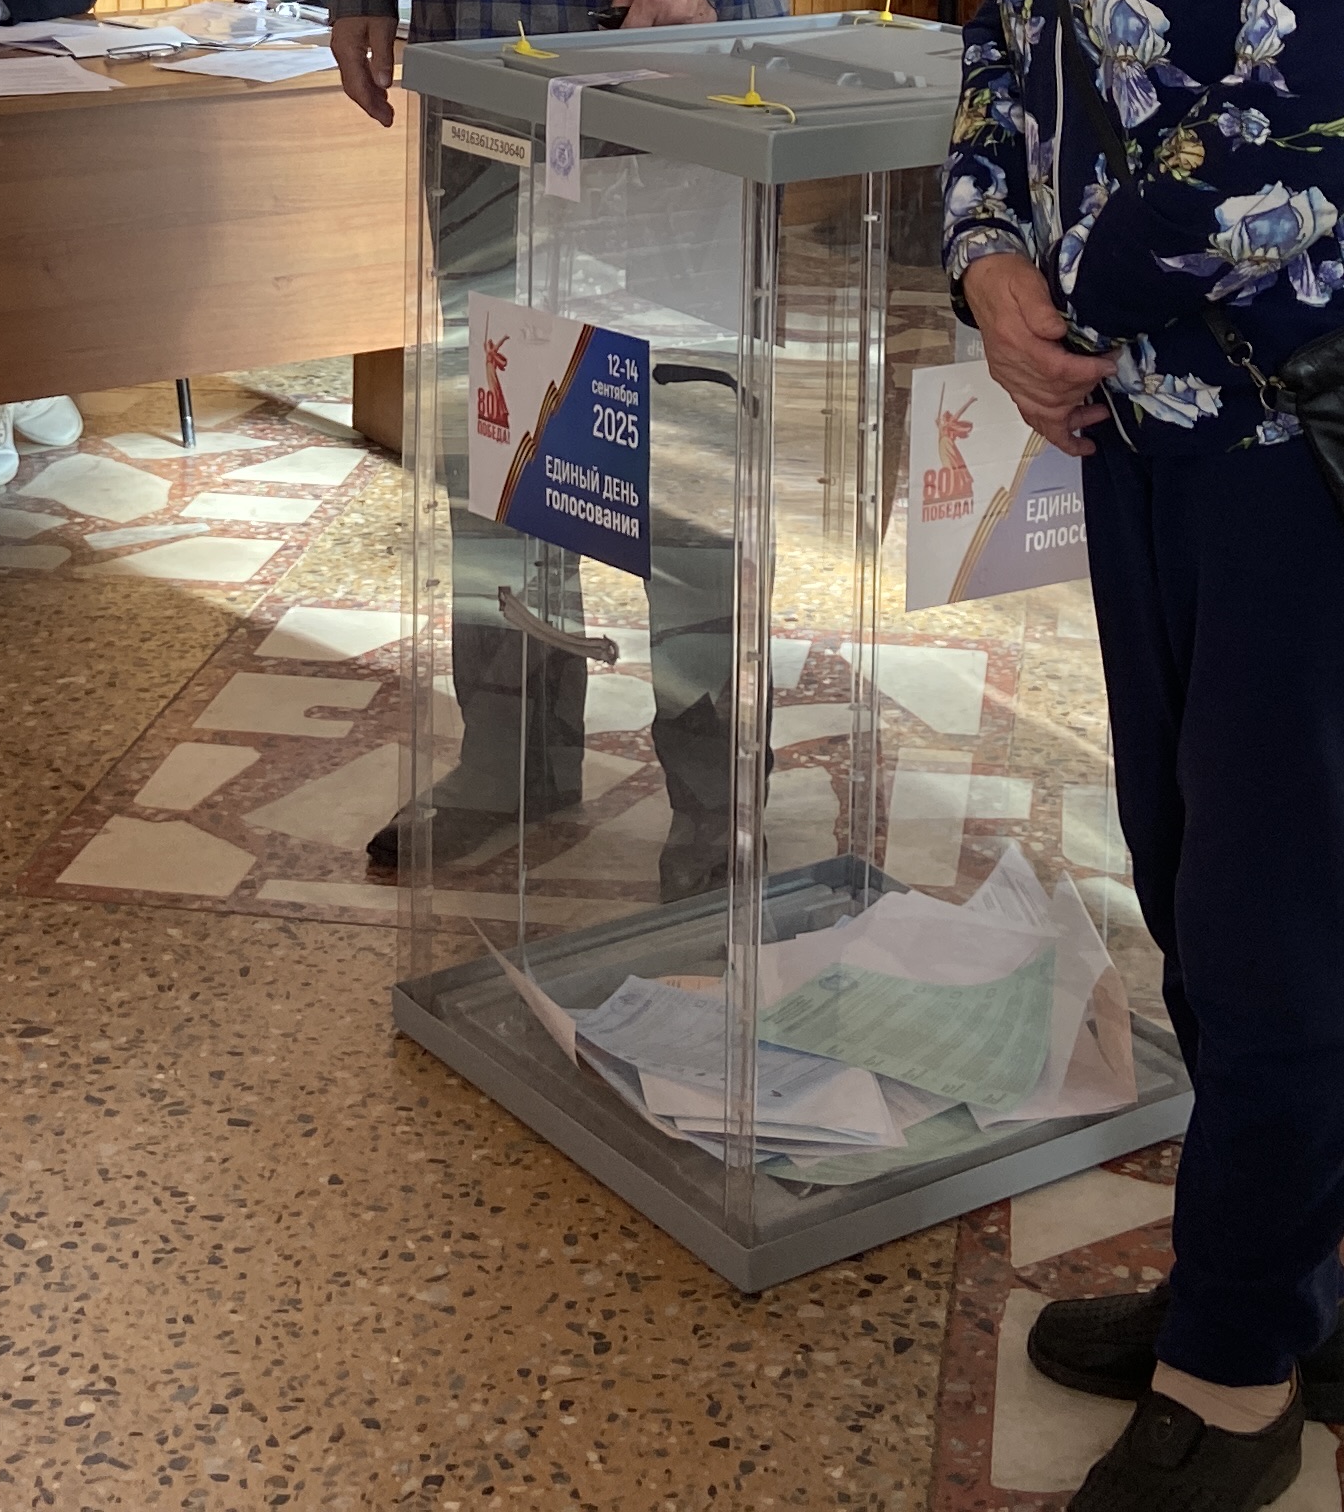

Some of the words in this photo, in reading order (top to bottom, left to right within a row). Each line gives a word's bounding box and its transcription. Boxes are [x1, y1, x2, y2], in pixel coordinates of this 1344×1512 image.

[452, 126, 525, 159] 949163612530640
[607, 353, 639, 382] 12-14
[592, 379, 639, 407] сентября
[593, 404, 639, 449] 2025
[546, 454, 600, 493] ЕДИНЫЙ
[603, 475, 639, 507] ДЕНЬ
[546, 488, 640, 539] голосования
[922, 498, 974, 522] ПОБЕДА!
